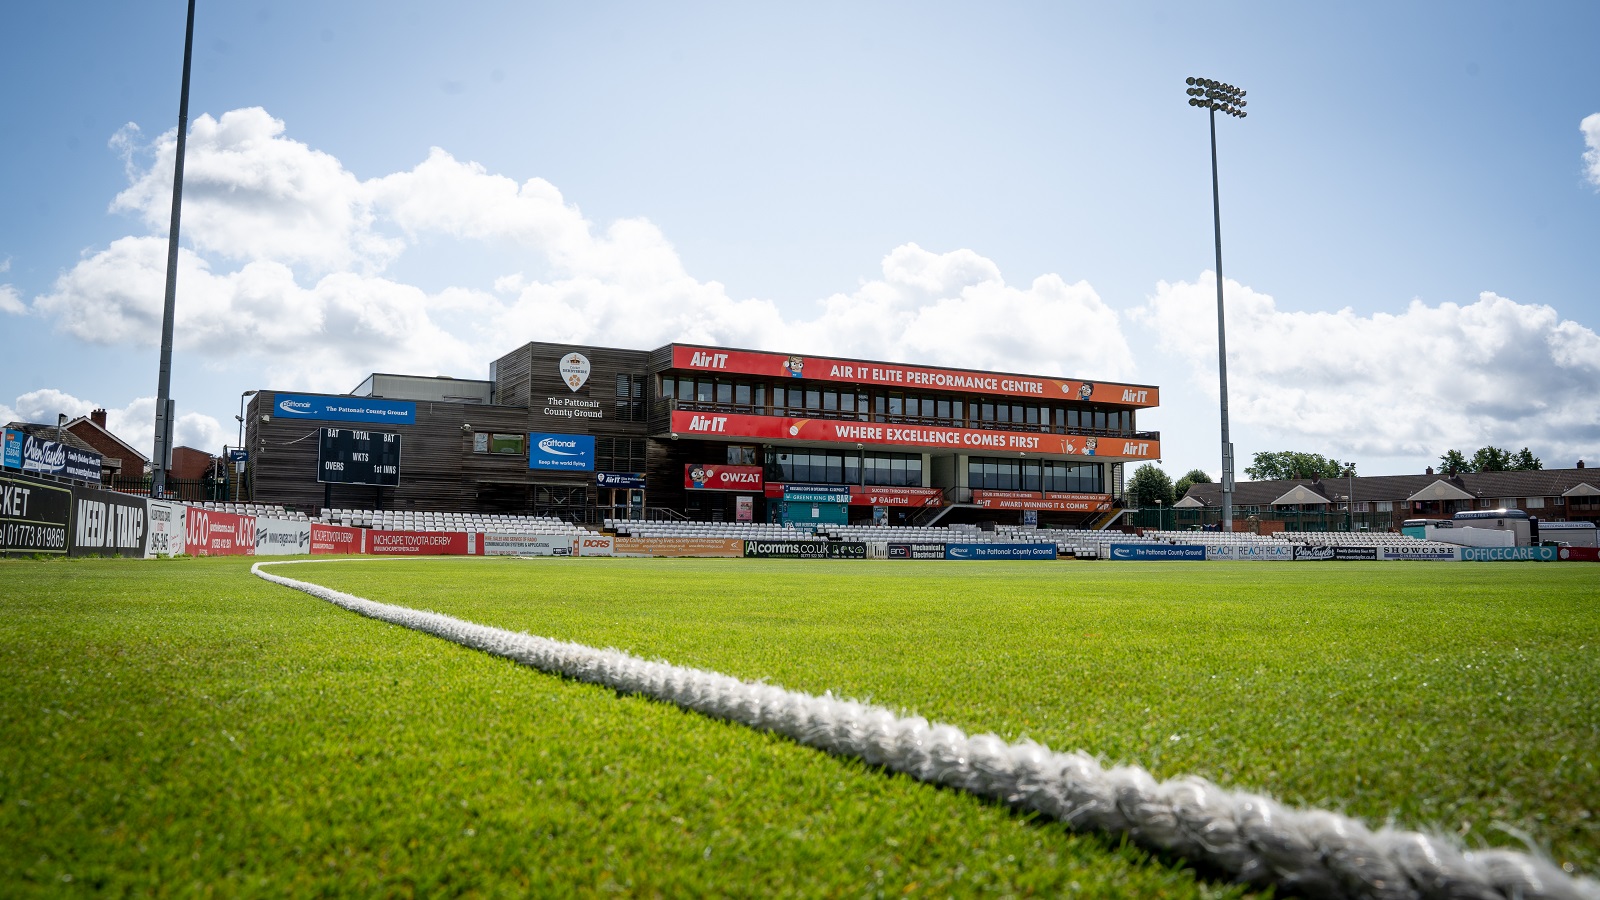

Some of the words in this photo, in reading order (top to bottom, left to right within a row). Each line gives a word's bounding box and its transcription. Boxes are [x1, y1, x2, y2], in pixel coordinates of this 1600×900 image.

[830, 365, 853, 378] AIR
[857, 367, 868, 379] IT
[872, 368, 902, 382] ELITE
[907, 371, 997, 390] PERFORMANCE
[1001, 380, 1042, 393] CENTRE
[547, 397, 562, 406] The
[564, 398, 600, 408] Pattonair
[544, 407, 572, 418] County
[574, 410, 602, 418] Ground
[328, 429, 339, 437] BAT
[353, 431, 370, 440] TOTAL
[384, 434, 394, 442] BAT
[835, 425, 882, 439] WHERE
[887, 428, 959, 443] EXCELLENCE
[964, 433, 1006, 447] COMES
[1010, 436, 1039, 448] FIRST
[542, 440, 576, 449] pattonair
[42, 441, 66, 473] Taylor
[353, 452, 369, 462] WKTS
[325, 461, 344, 471] OVERS
[374, 465, 382, 473] 1st
[383, 465, 396, 474] INNS
[720, 473, 760, 483] OWZAT
[76, 499, 106, 547] NEED
[106, 504, 114, 547] A
[117, 505, 143, 548] TAXI?
[7, 524, 34, 546] 01773
[36, 526, 65, 548] 819869
[327, 530, 340, 542] TOYOTA
[341, 532, 353, 542] DERBY
[374, 535, 403, 544] INCHCAPE
[405, 536, 428, 545] TOYOTA
[430, 537, 451, 546] DERBY
[583, 540, 610, 548] DCRS
[1207, 546, 1233, 555] REACH
[1239, 546, 1263, 555] REACH
[1266, 546, 1291, 555] REACH
[1465, 548, 1533, 560] OFFICECARE
